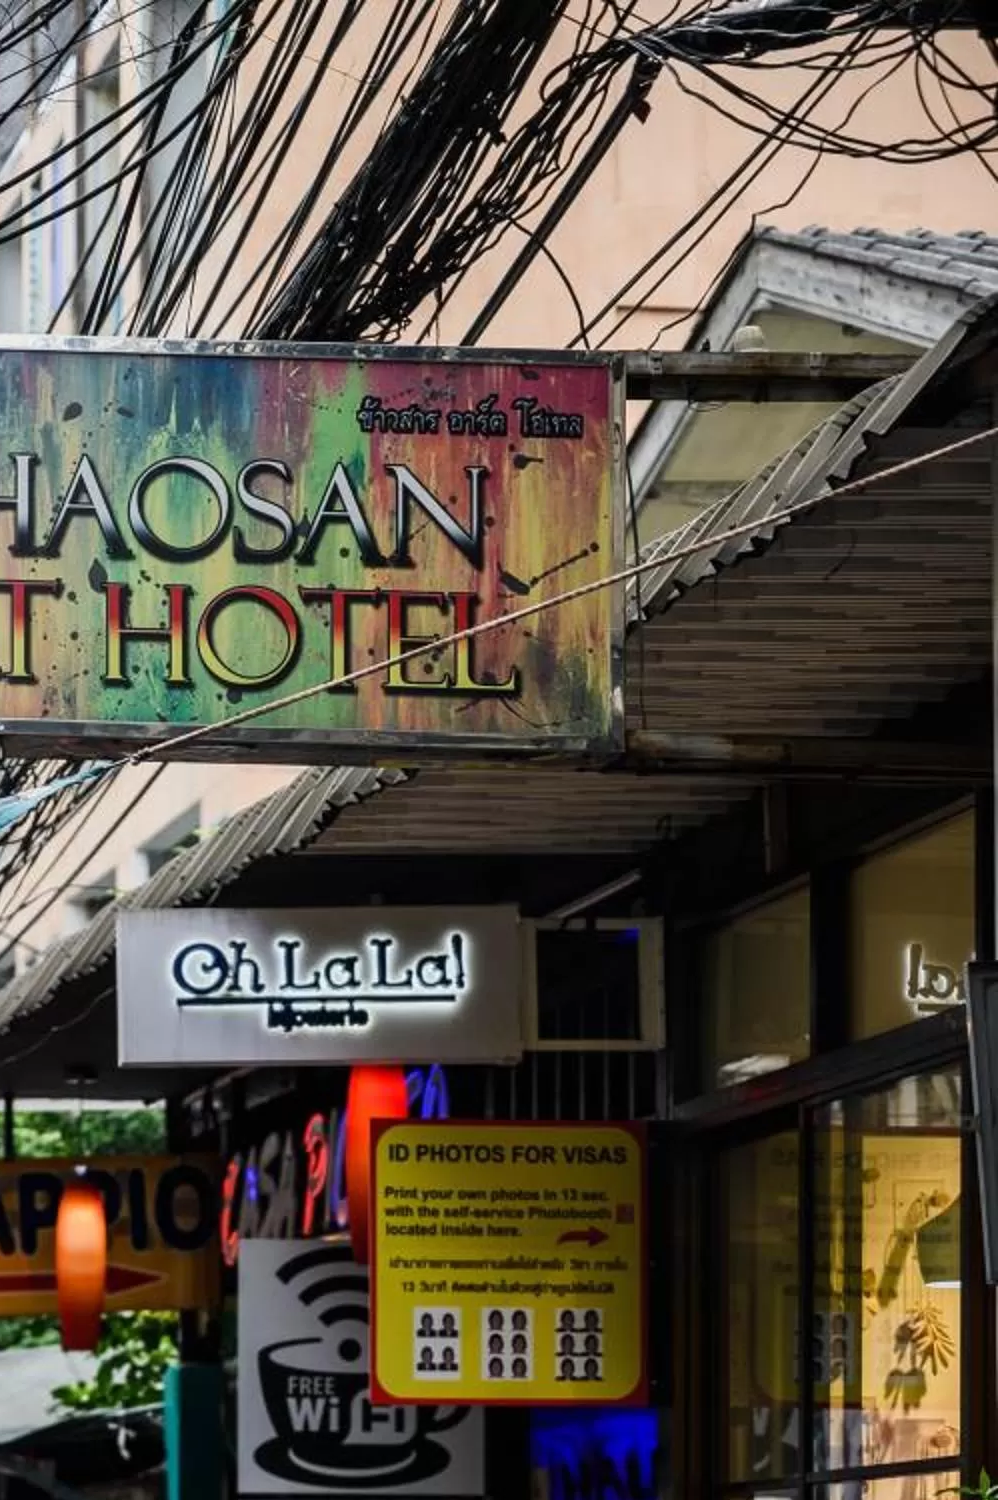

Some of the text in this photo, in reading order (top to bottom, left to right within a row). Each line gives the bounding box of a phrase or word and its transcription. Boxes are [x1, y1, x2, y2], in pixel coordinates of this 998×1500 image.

[102, 580, 522, 698] HOTEL
[173, 940, 265, 996] Oh
[388, 1144, 628, 1164] ID PHOTOS FOR VISAS
[384, 1186, 418, 1199] Print
[421, 1189, 454, 1202] your
[457, 1191, 487, 1201] own
[490, 1188, 539, 1202] photos
[544, 1189, 557, 1201] in
[384, 1204, 414, 1217] with
[417, 1205, 440, 1217] the
[443, 1206, 524, 1219] self-service
[385, 1223, 437, 1236] located
[441, 1224, 483, 1237] inside
[287, 1376, 336, 1395] FREE
